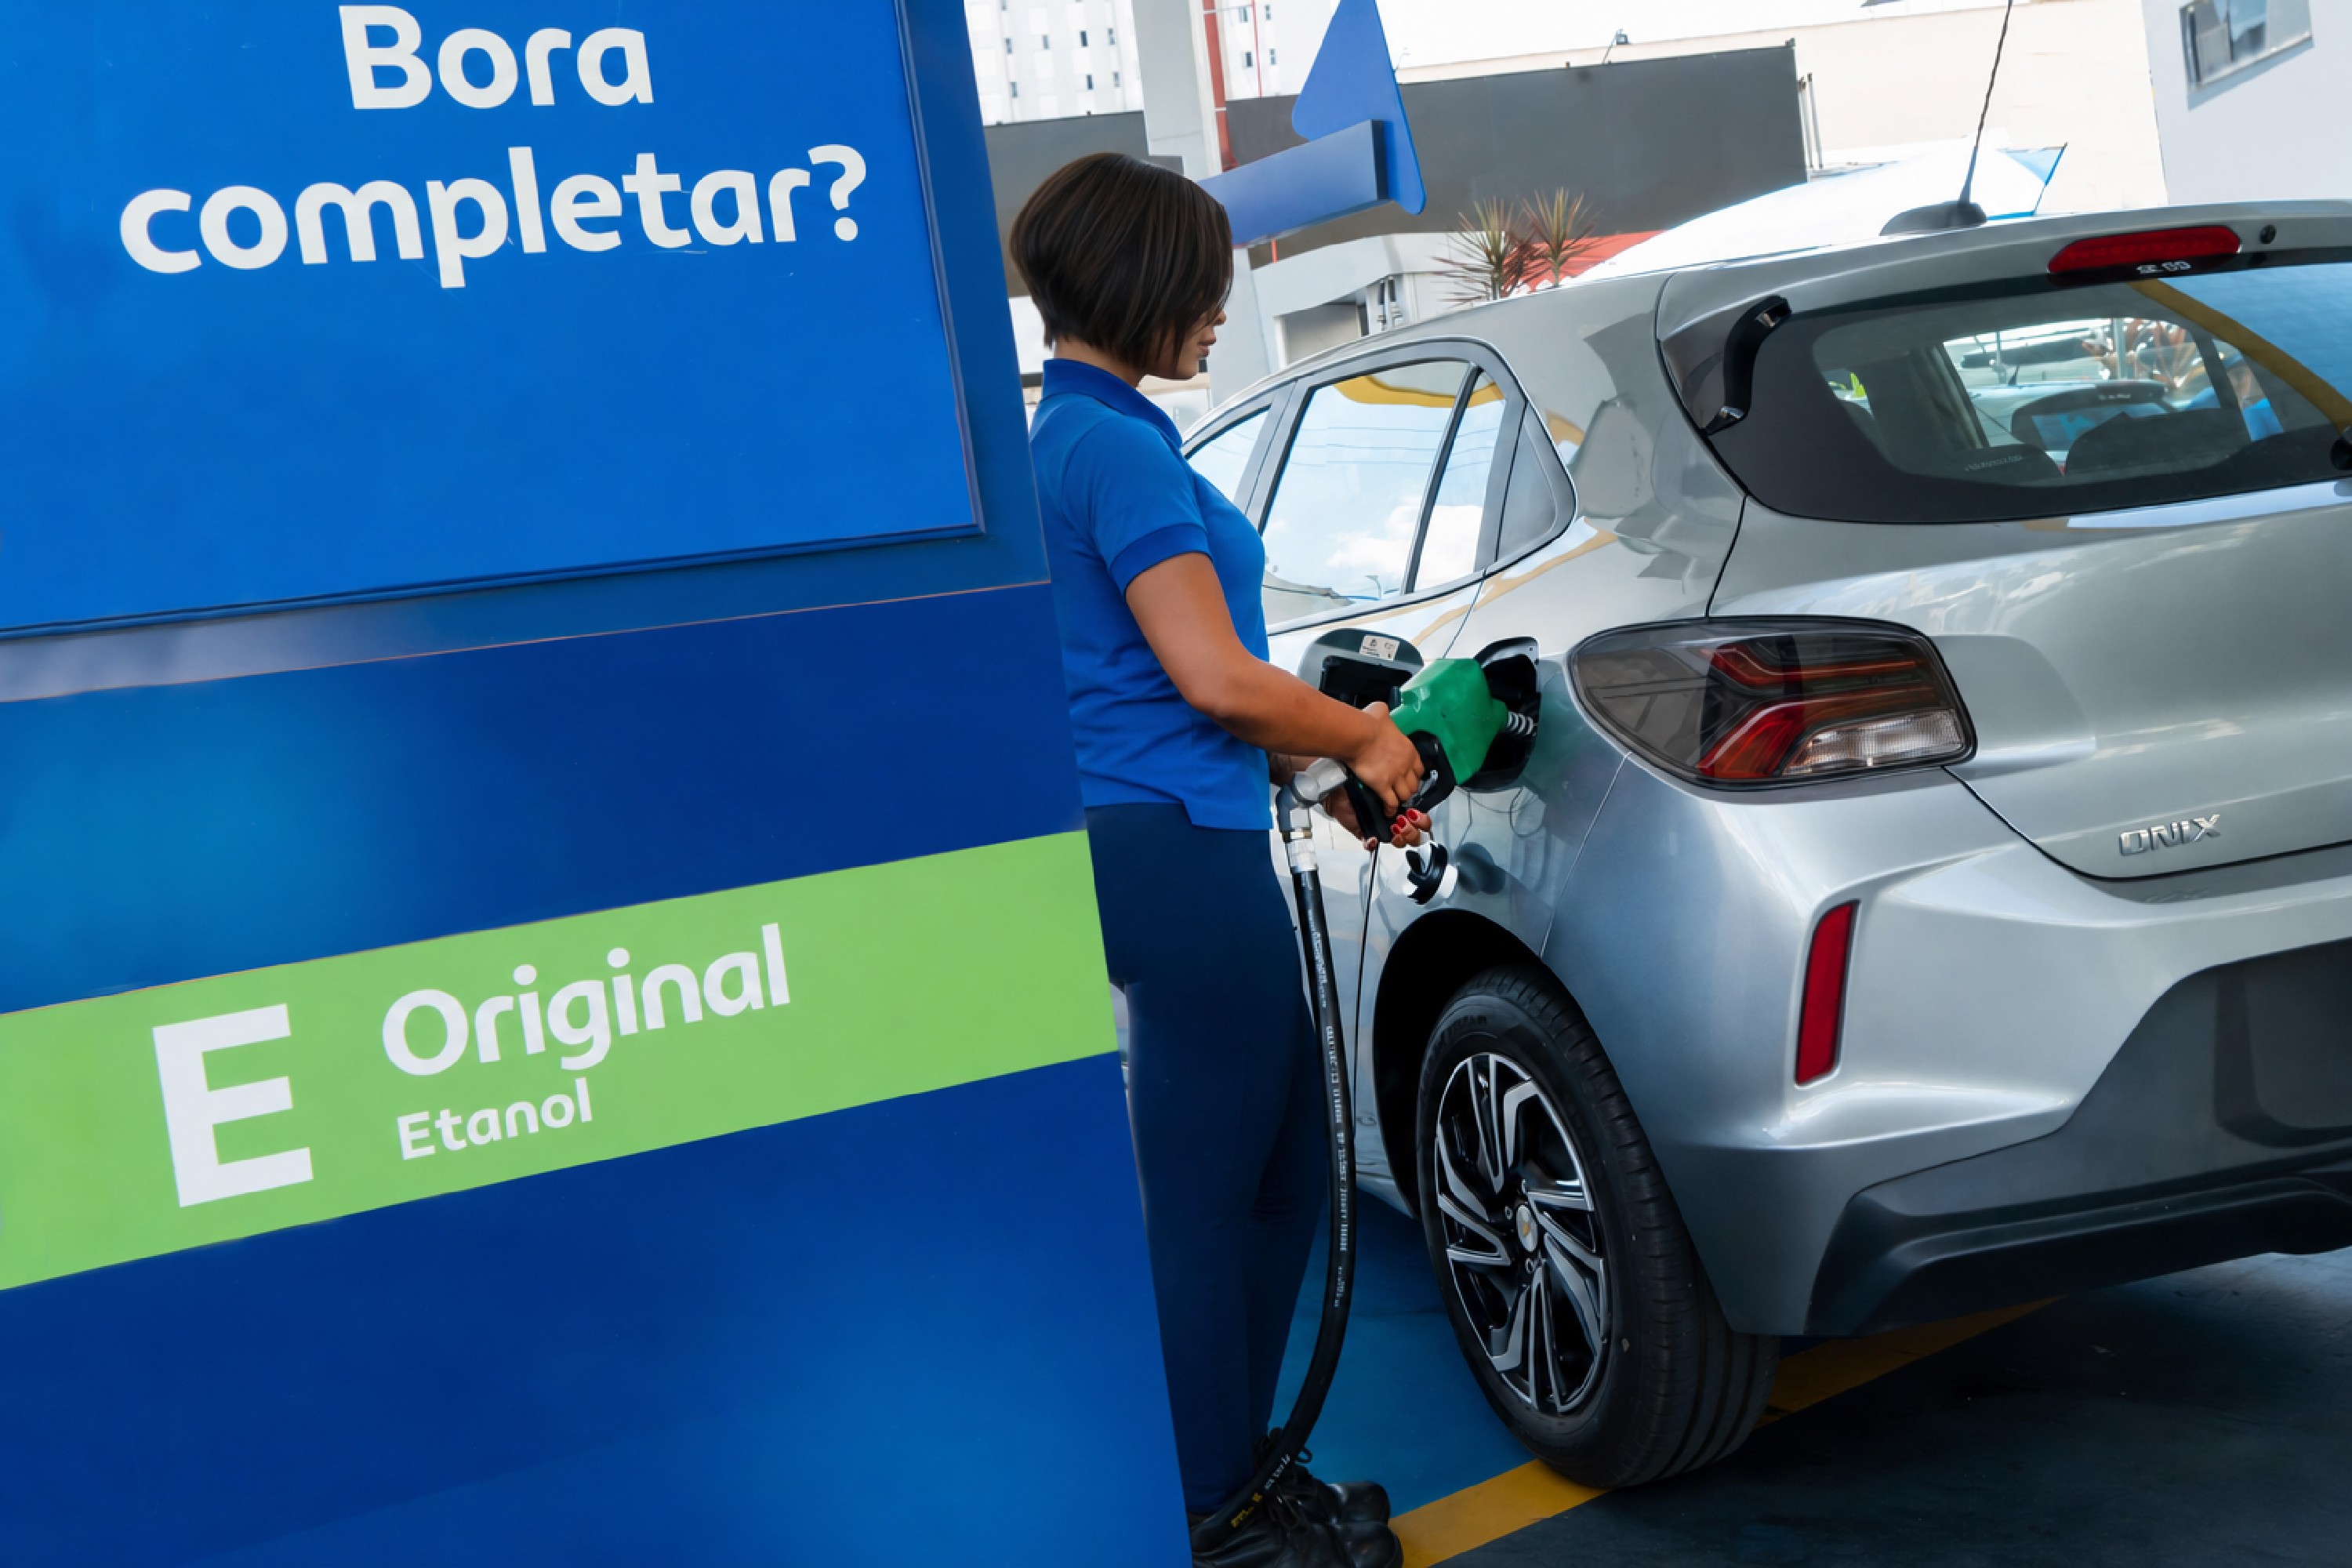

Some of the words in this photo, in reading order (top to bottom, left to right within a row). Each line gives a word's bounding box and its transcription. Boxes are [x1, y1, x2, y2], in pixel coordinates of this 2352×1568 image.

[339, 5, 654, 110] Bora
[119, 144, 867, 289] completar?
[2118, 814, 2221, 856] ONIX
[382, 923, 791, 1076] Original
[152, 1004, 314, 1208] E
[397, 1078, 593, 1161] Etanol
